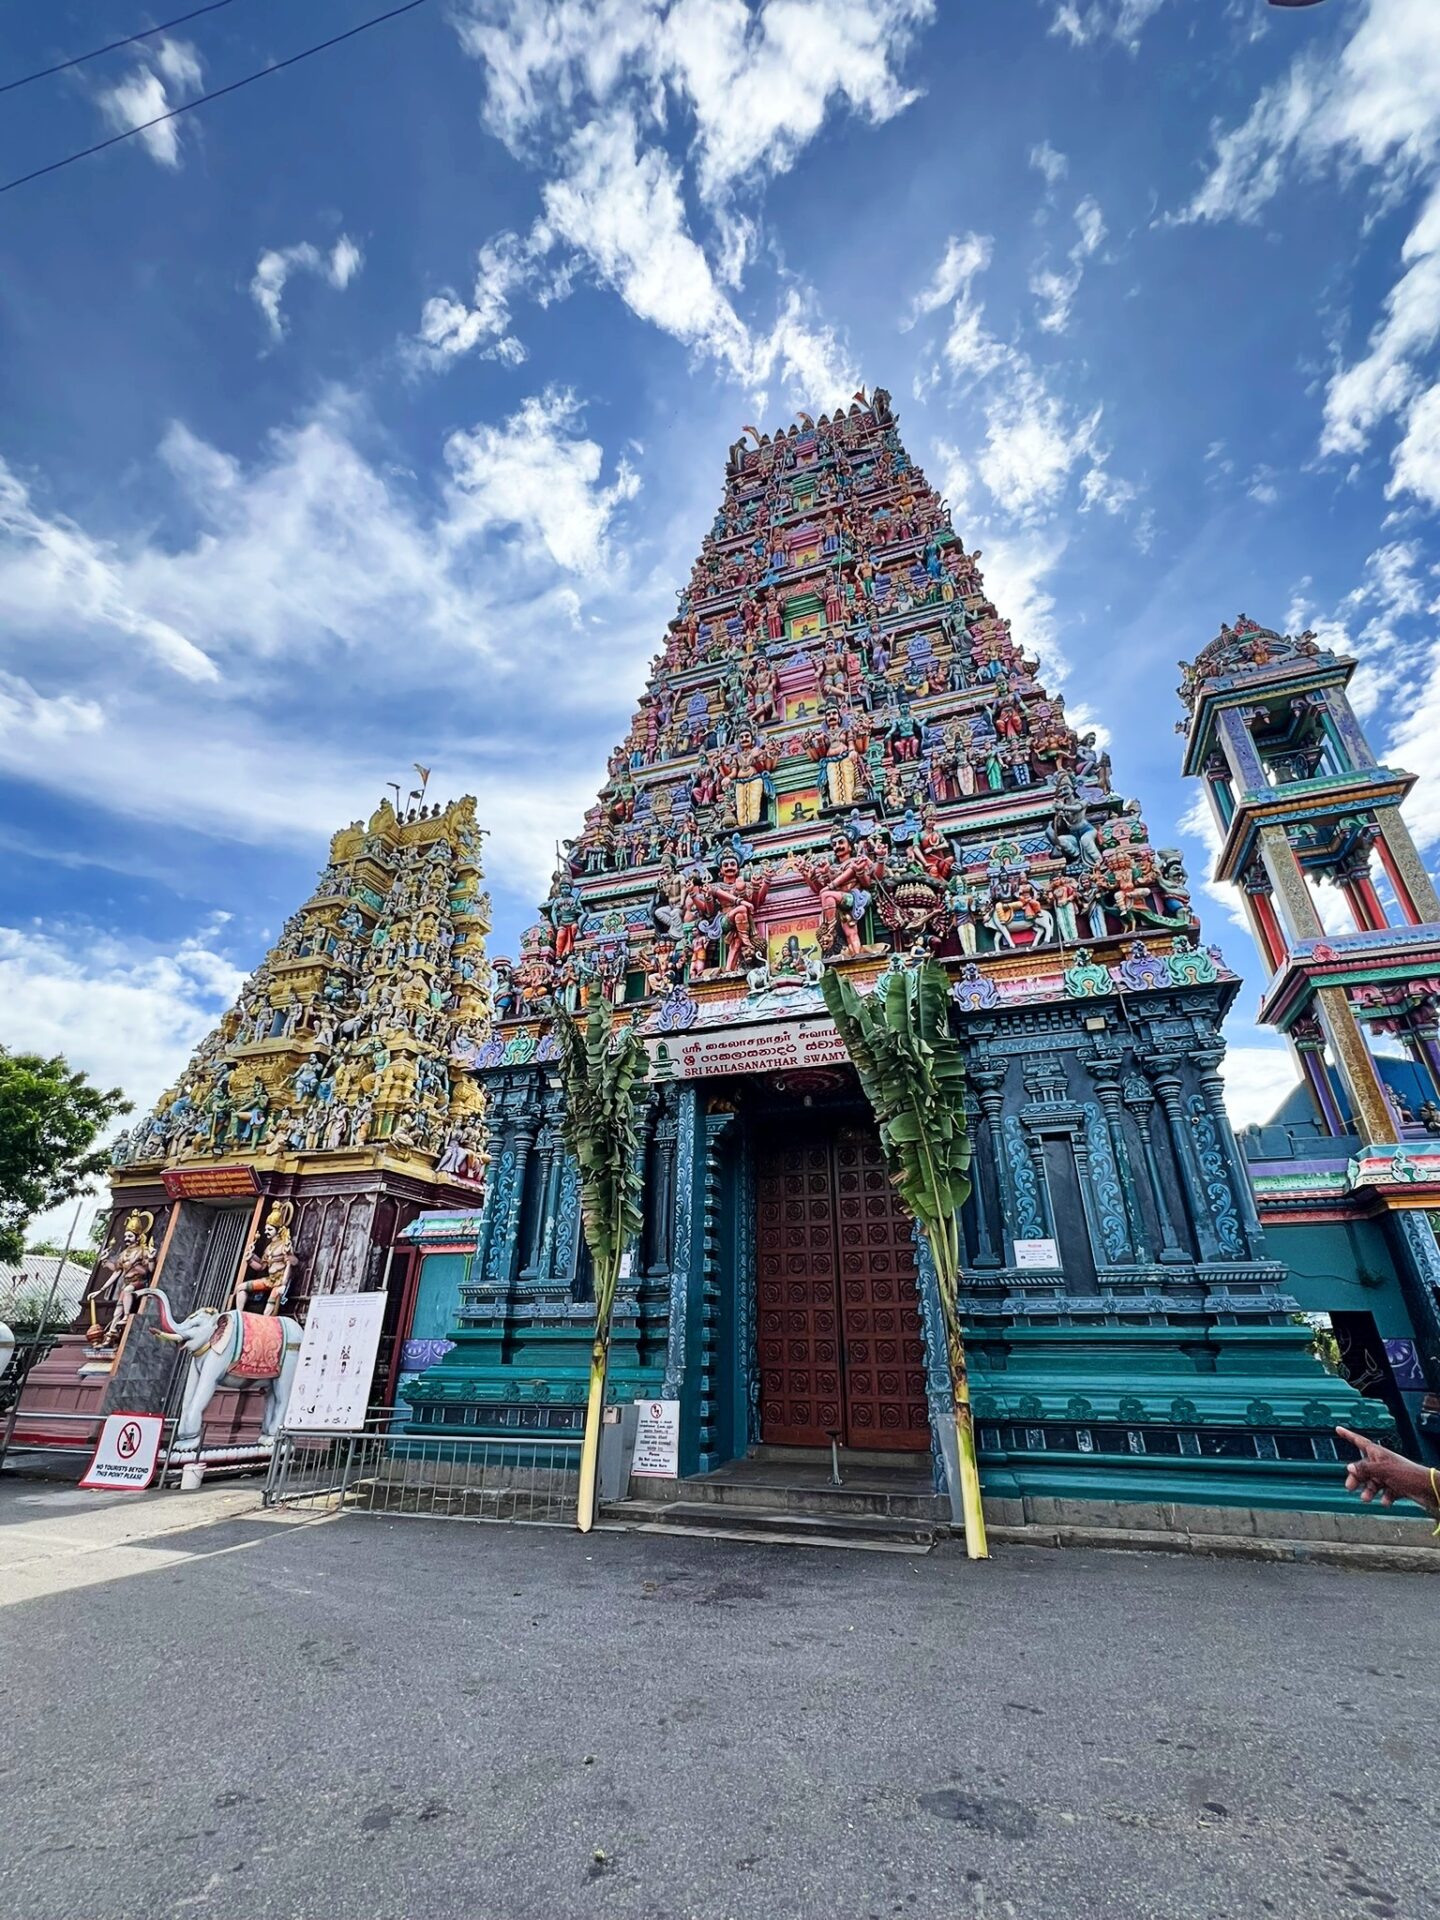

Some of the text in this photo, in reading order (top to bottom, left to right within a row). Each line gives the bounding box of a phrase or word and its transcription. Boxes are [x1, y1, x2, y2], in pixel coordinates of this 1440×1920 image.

[684, 1051, 847, 1076] SRI KAILASANATHAR SWAMY
[104, 1464, 128, 1472] TOURISTS
[123, 1472, 143, 1480] PLEASE
